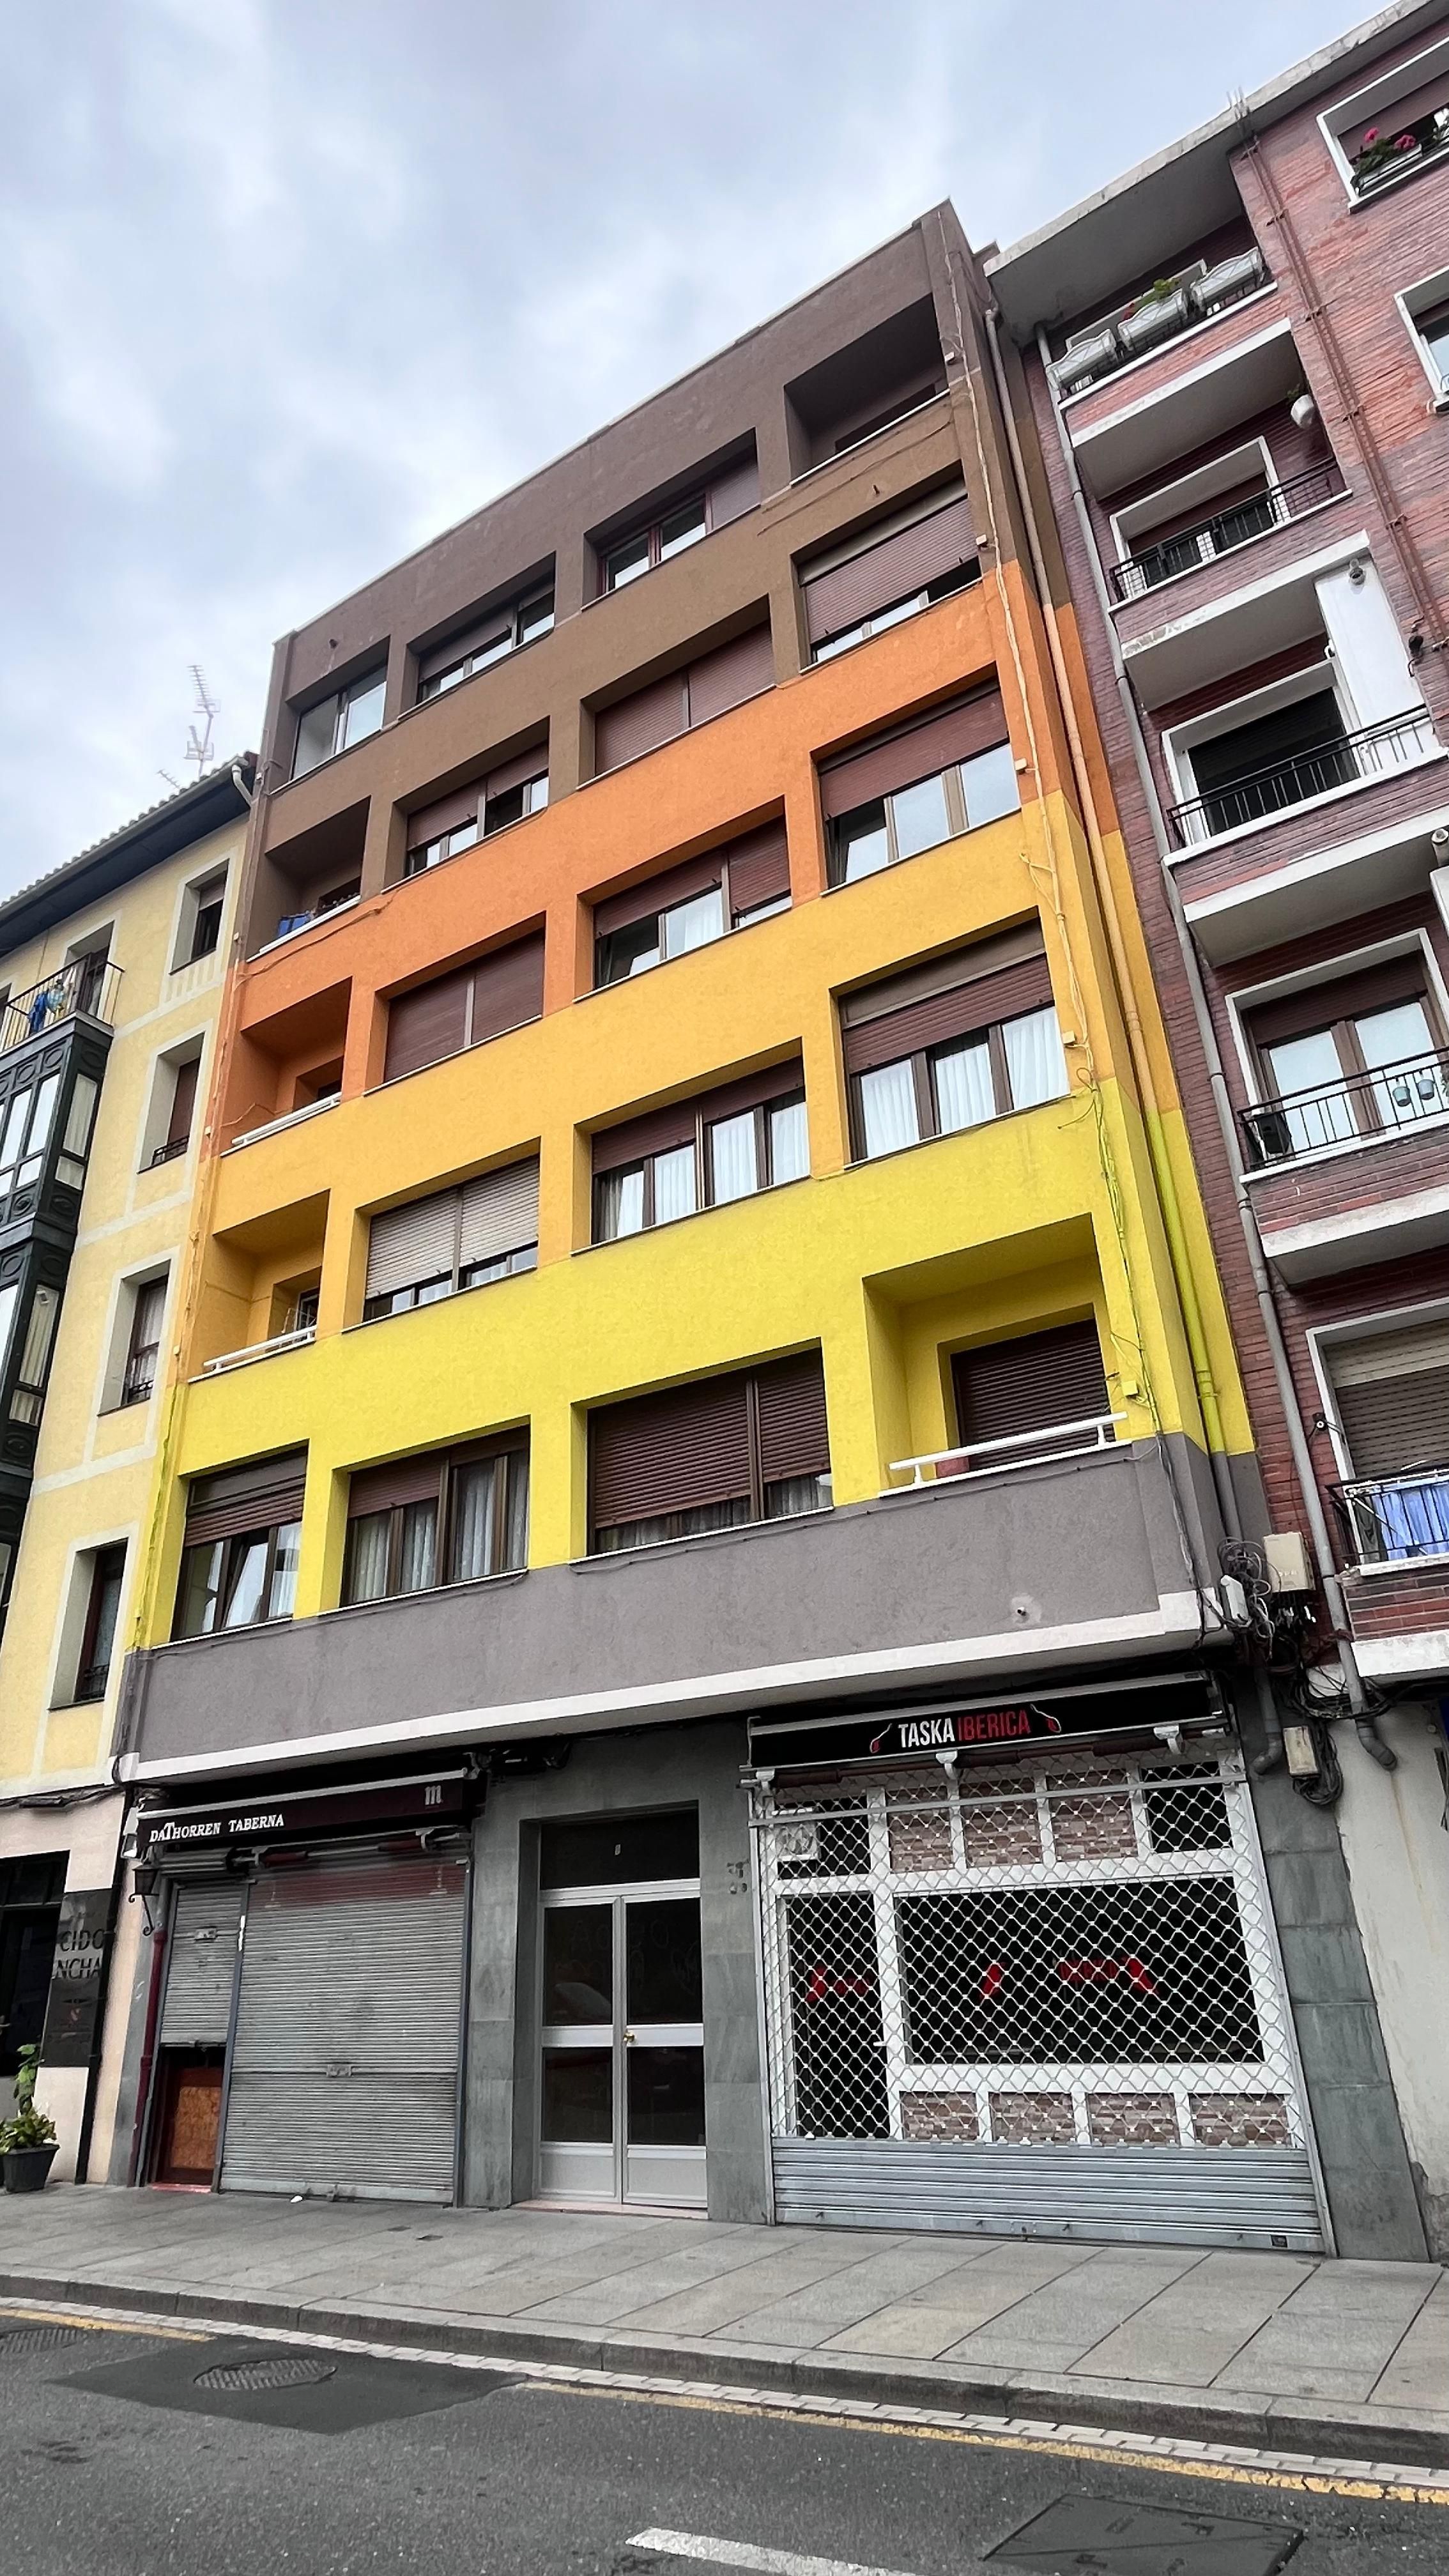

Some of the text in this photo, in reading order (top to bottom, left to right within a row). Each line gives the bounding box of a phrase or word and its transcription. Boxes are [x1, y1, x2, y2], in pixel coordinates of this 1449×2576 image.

[898, 1710, 1031, 1748] TASKA IBERICA
[228, 1814, 284, 1832] TABERNA
